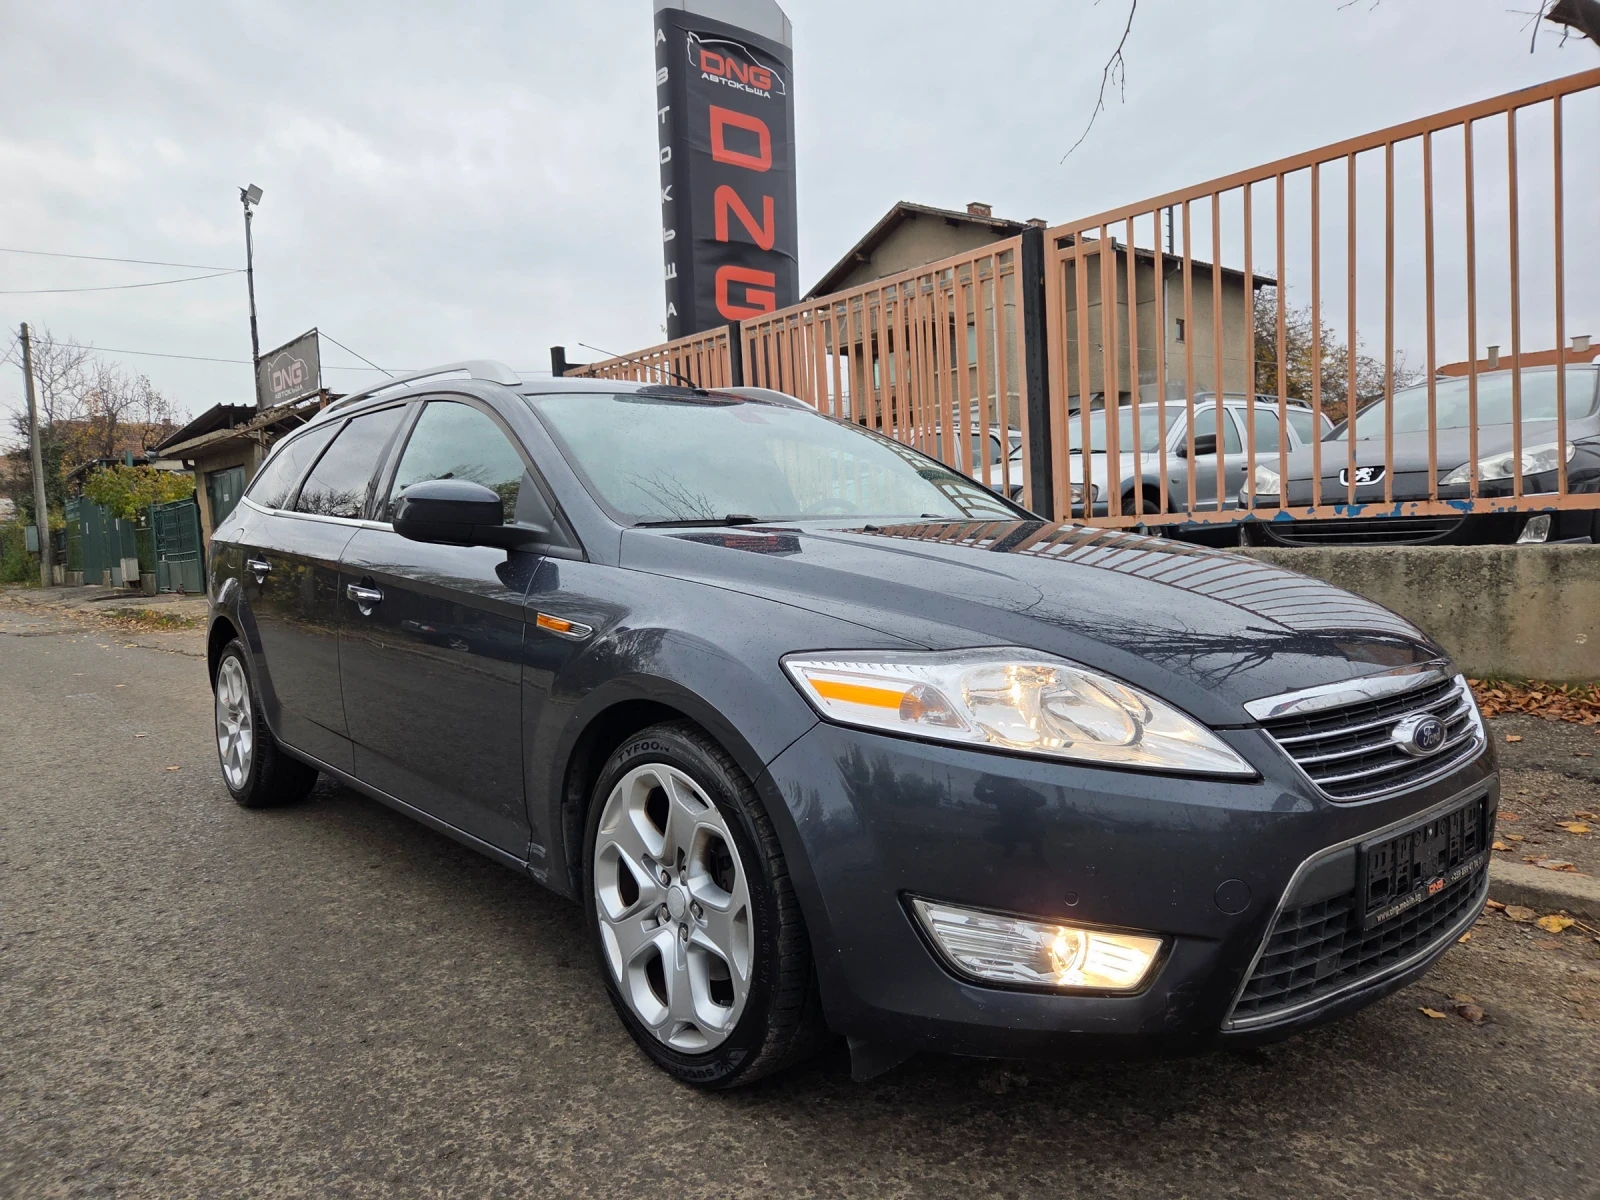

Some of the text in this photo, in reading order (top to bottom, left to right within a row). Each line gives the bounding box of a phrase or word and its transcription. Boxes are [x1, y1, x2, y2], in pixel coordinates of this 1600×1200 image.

[699, 49, 772, 91] DNG
[700, 72, 771, 99] АВТОКЪЩА
[709, 104, 776, 321] DNG
[273, 362, 302, 392] DNG
[1423, 725, 1441, 746] Ford
